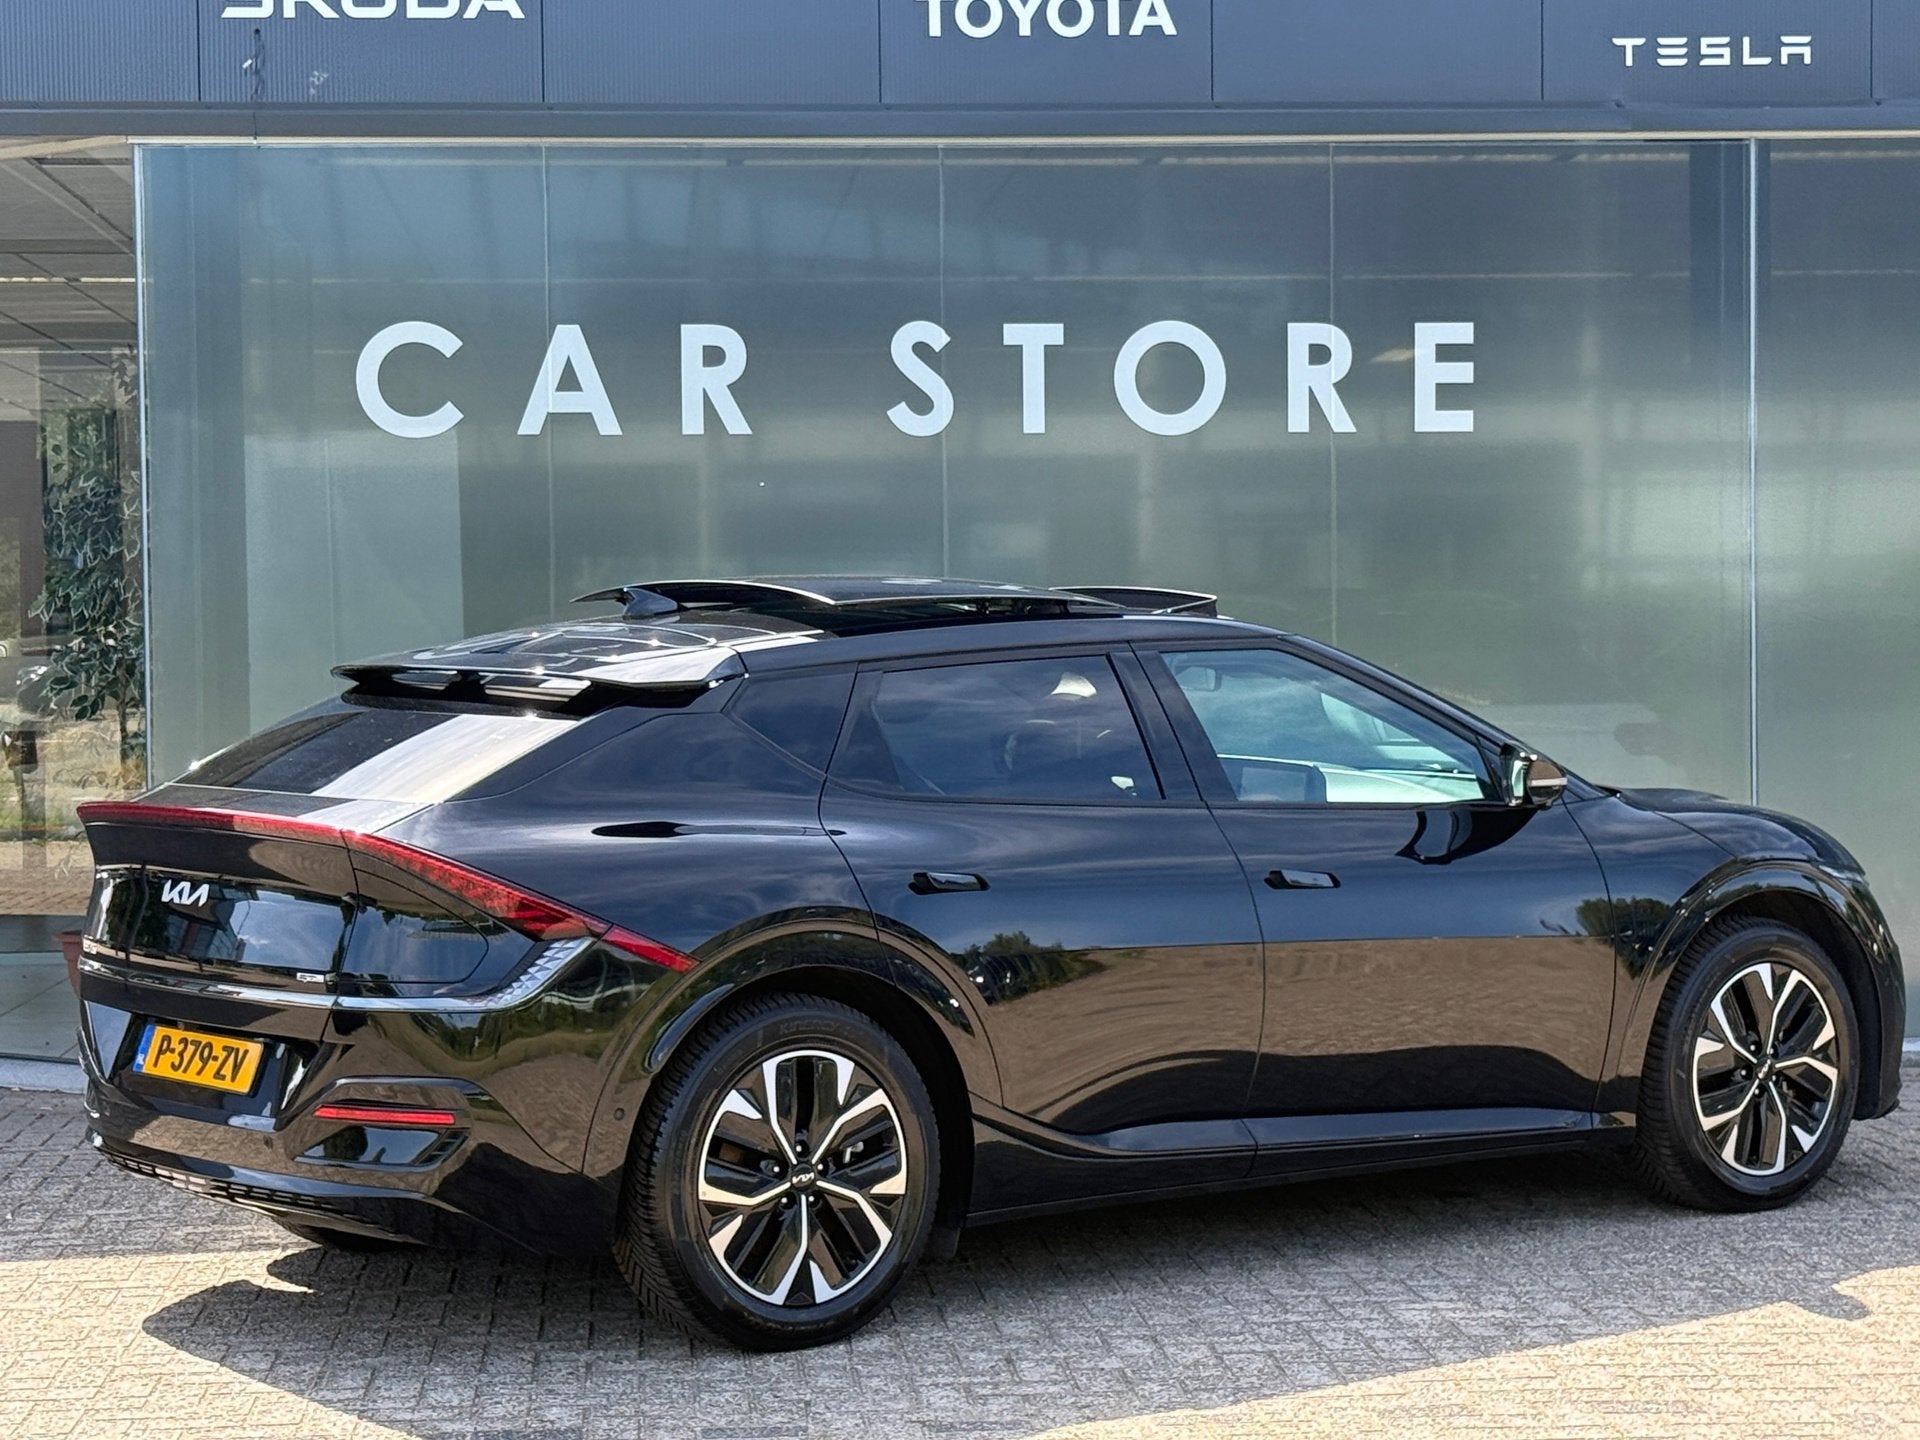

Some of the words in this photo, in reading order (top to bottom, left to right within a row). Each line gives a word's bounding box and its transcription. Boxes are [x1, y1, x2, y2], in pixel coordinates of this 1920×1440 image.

[915, 0, 1178, 38] TOYOTA
[1611, 35, 1812, 67] TESLA
[355, 320, 753, 439] CAR
[886, 320, 1474, 437] STORE
[161, 879, 210, 907] KIA
[152, 1034, 250, 1083] P-379-ZV
